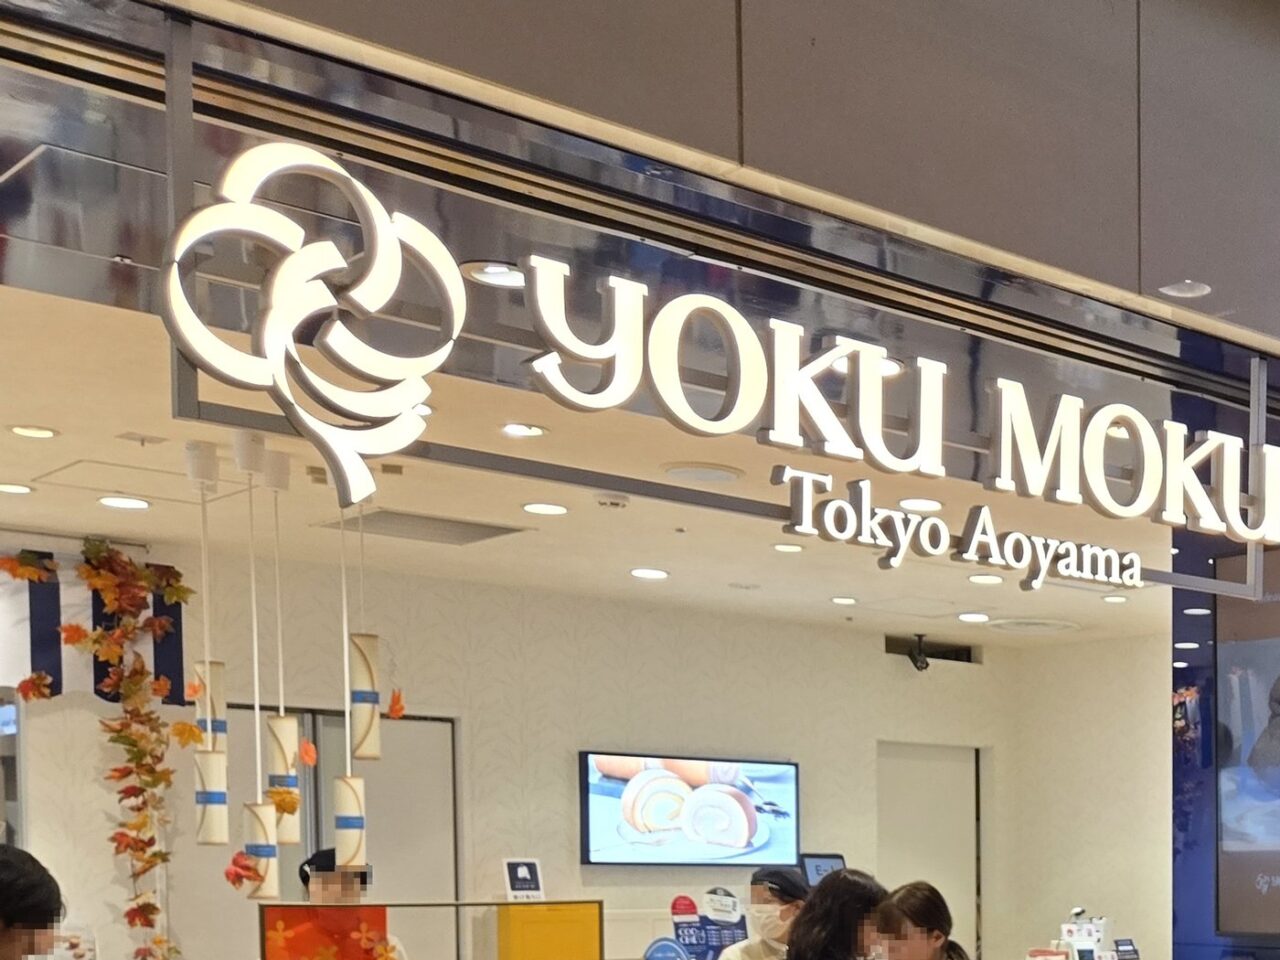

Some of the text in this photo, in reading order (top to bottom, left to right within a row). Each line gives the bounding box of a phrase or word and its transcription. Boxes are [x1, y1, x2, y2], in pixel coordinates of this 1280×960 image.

[526, 254, 947, 481] YOKU
[776, 465, 1144, 590] Tokyo Aoyama
